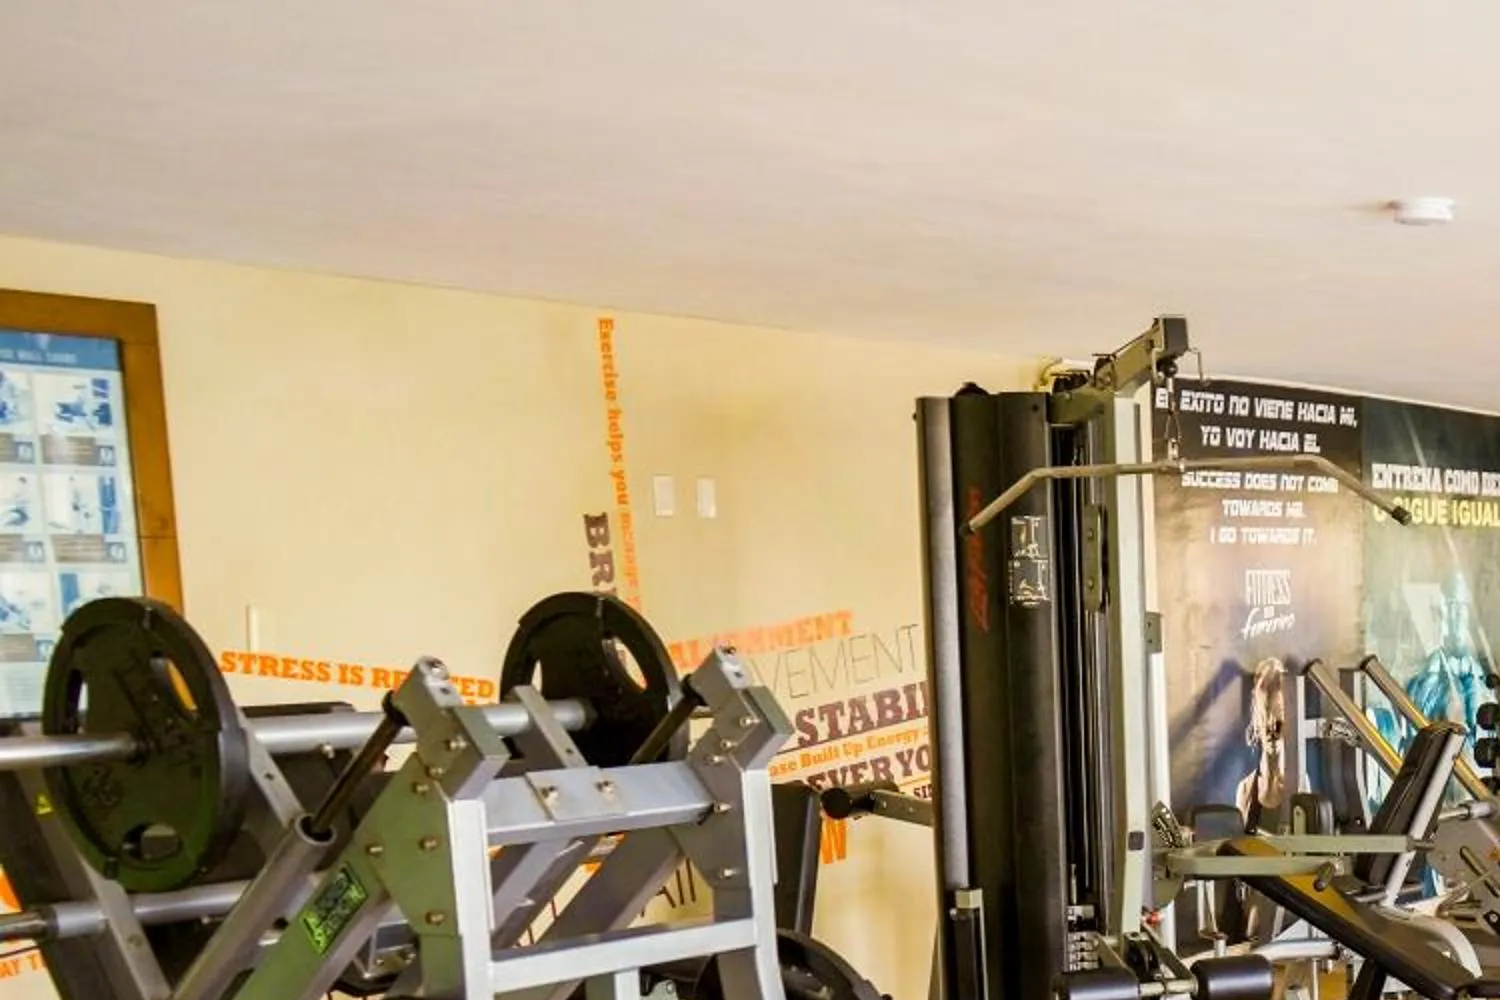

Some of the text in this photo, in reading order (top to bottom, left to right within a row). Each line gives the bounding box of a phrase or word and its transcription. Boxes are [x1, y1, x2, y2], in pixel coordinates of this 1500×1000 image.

[597, 318, 619, 401] Exercise
[1229, 395, 1249, 417] NO
[1254, 397, 1295, 421] VIENE
[1298, 401, 1336, 425] HACIA
[606, 409, 624, 463] helps
[1201, 425, 1221, 447] YO
[1226, 427, 1255, 449] VOY
[1259, 429, 1299, 452] HACIA
[609, 469, 630, 505] you
[1181, 471, 1241, 489] SUCCESS
[1244, 473, 1277, 490] DOES
[1280, 474, 1304, 492] NOT
[1372, 463, 1442, 492] ENTRENA
[1445, 469, 1480, 496] COMO
[1222, 499, 1282, 517] TOWARDS
[1219, 526, 1237, 543] GO
[1240, 526, 1300, 545] TOWARDS
[1246, 569, 1291, 606] FITNESS
[219, 651, 332, 683] STRESS
[338, 665, 364, 686] IS
[752, 624, 918, 699] VEMENT
[801, 744, 840, 768] Built
[843, 741, 863, 757] Up
